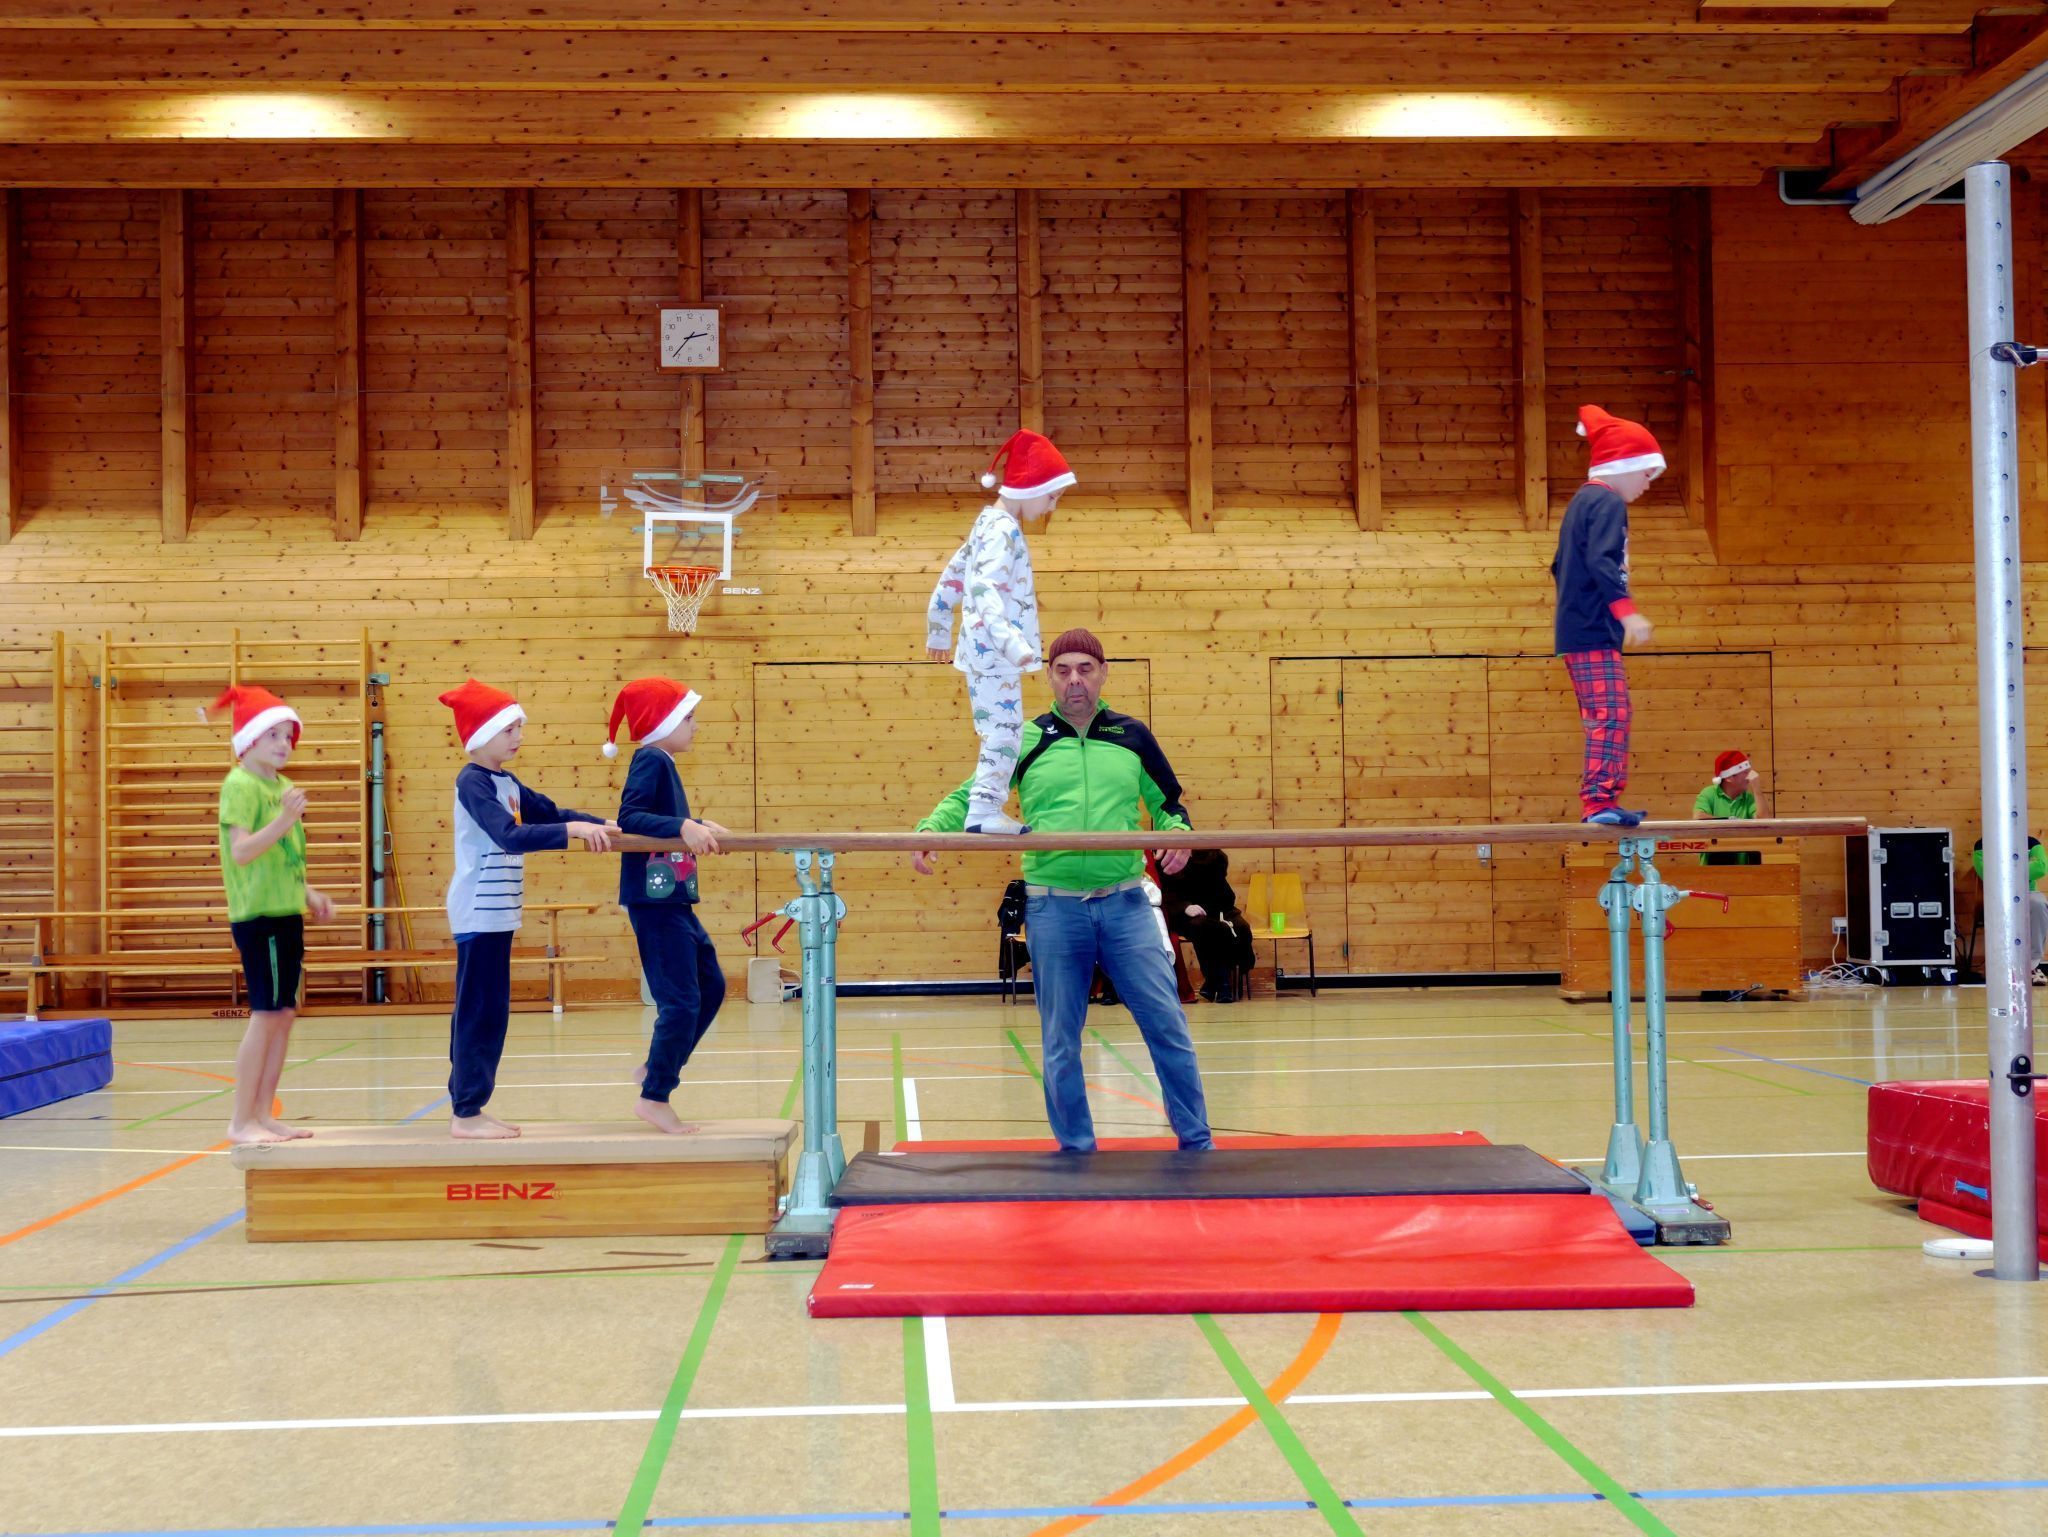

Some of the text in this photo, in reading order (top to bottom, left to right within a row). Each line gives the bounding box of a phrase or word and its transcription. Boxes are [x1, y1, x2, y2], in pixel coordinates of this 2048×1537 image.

[706, 323, 711, 331] 2
[722, 587, 763, 595] BENZ
[1657, 841, 1707, 850] BENZ
[446, 1182, 556, 1201] BENZ
